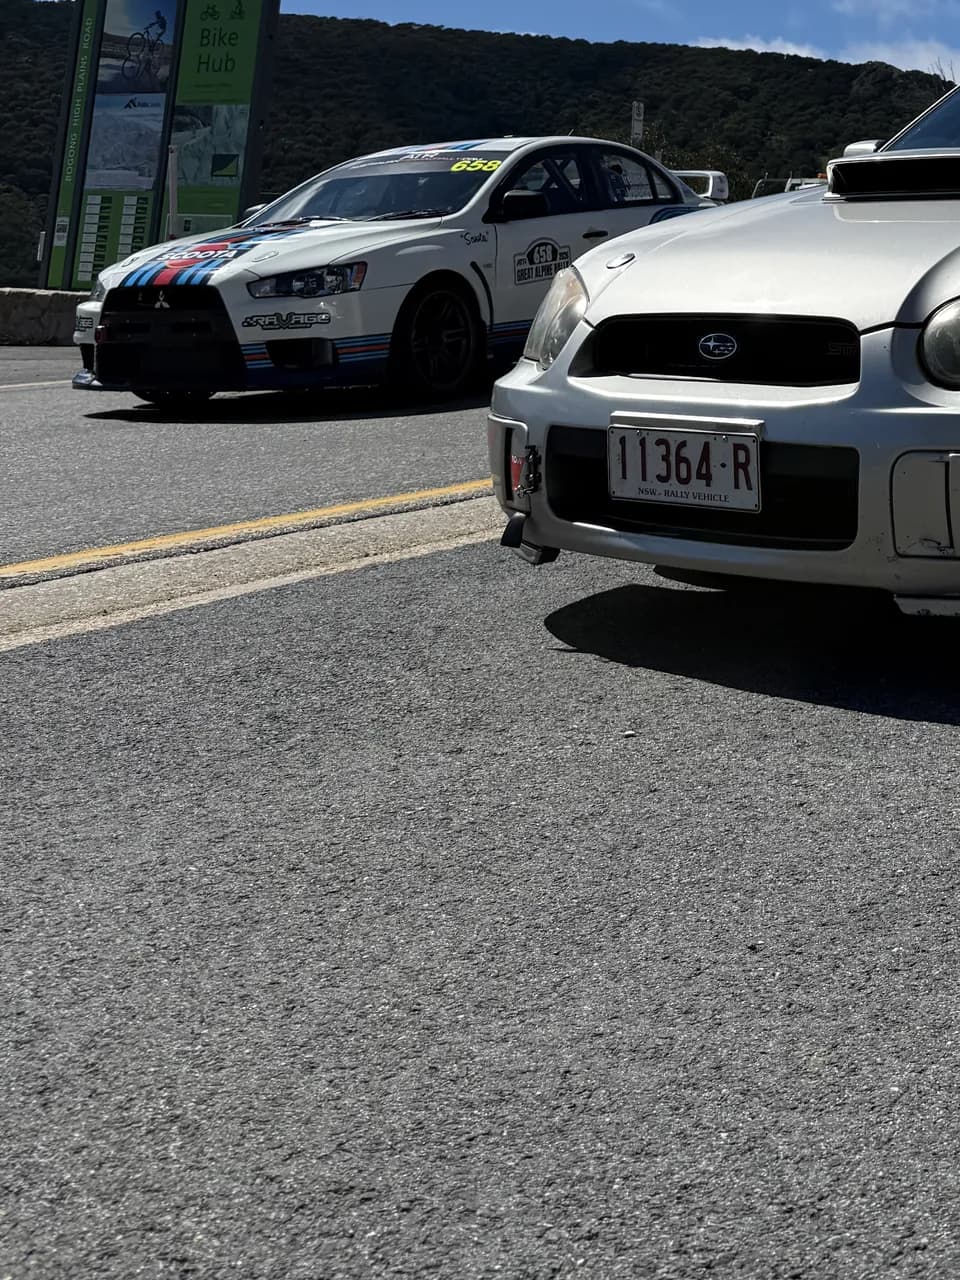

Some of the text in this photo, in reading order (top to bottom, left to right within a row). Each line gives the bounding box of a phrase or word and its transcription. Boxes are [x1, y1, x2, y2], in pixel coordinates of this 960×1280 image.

[199, 27, 239, 48] Bike
[76, 55, 88, 93] PLAINS
[83, 17, 93, 49] ROAD
[196, 52, 236, 73] Hub
[450, 160, 502, 172] 658
[160, 250, 237, 259] SCOOTA
[533, 245, 553, 264] 658
[517, 267, 534, 282] GREAT
[535, 263, 553, 278] ALPINE
[252, 313, 331, 329] RAVAGE
[638, 487, 657, 496] NSW
[664, 490, 690, 499] RALLY
[692, 492, 730, 503] VEHICLE
